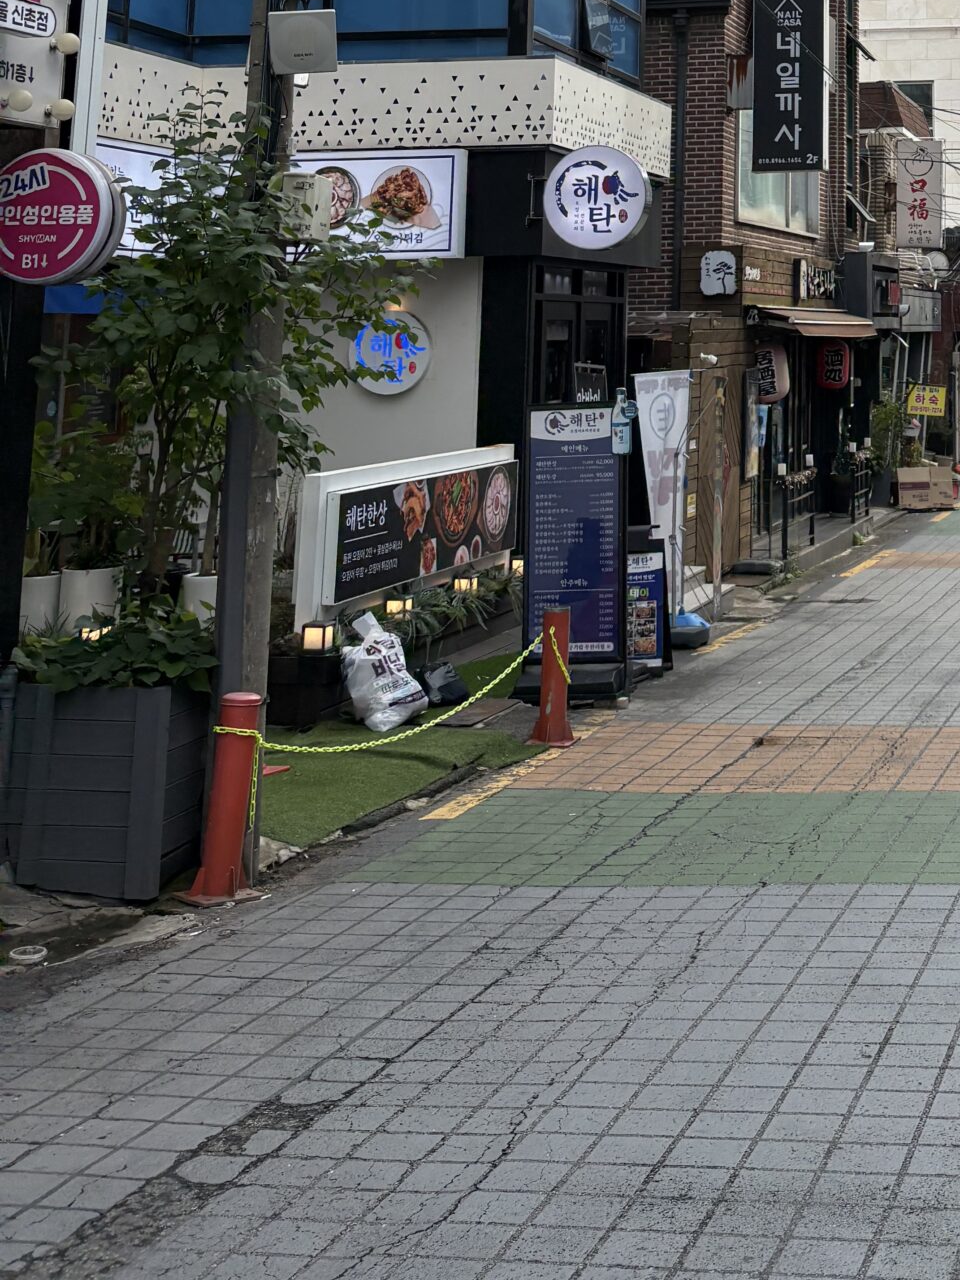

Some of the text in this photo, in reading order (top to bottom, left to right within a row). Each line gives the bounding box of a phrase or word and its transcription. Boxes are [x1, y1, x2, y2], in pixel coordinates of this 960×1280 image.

[11, 5, 50, 33] 신촌점
[777, 10, 802, 19] NAIL
[777, 18, 802, 27] CASA
[774, 31, 803, 151] 네일까사
[806, 153, 819, 165] 2F
[1, 165, 49, 199] 24시
[571, 174, 617, 234] 해탄
[18, 234, 57, 243] SHYMAN
[21, 253, 39, 269] B1
[914, 393, 940, 406] 하숙
[569, 412, 598, 428] 해탄
[345, 499, 389, 531] 해탄한상
